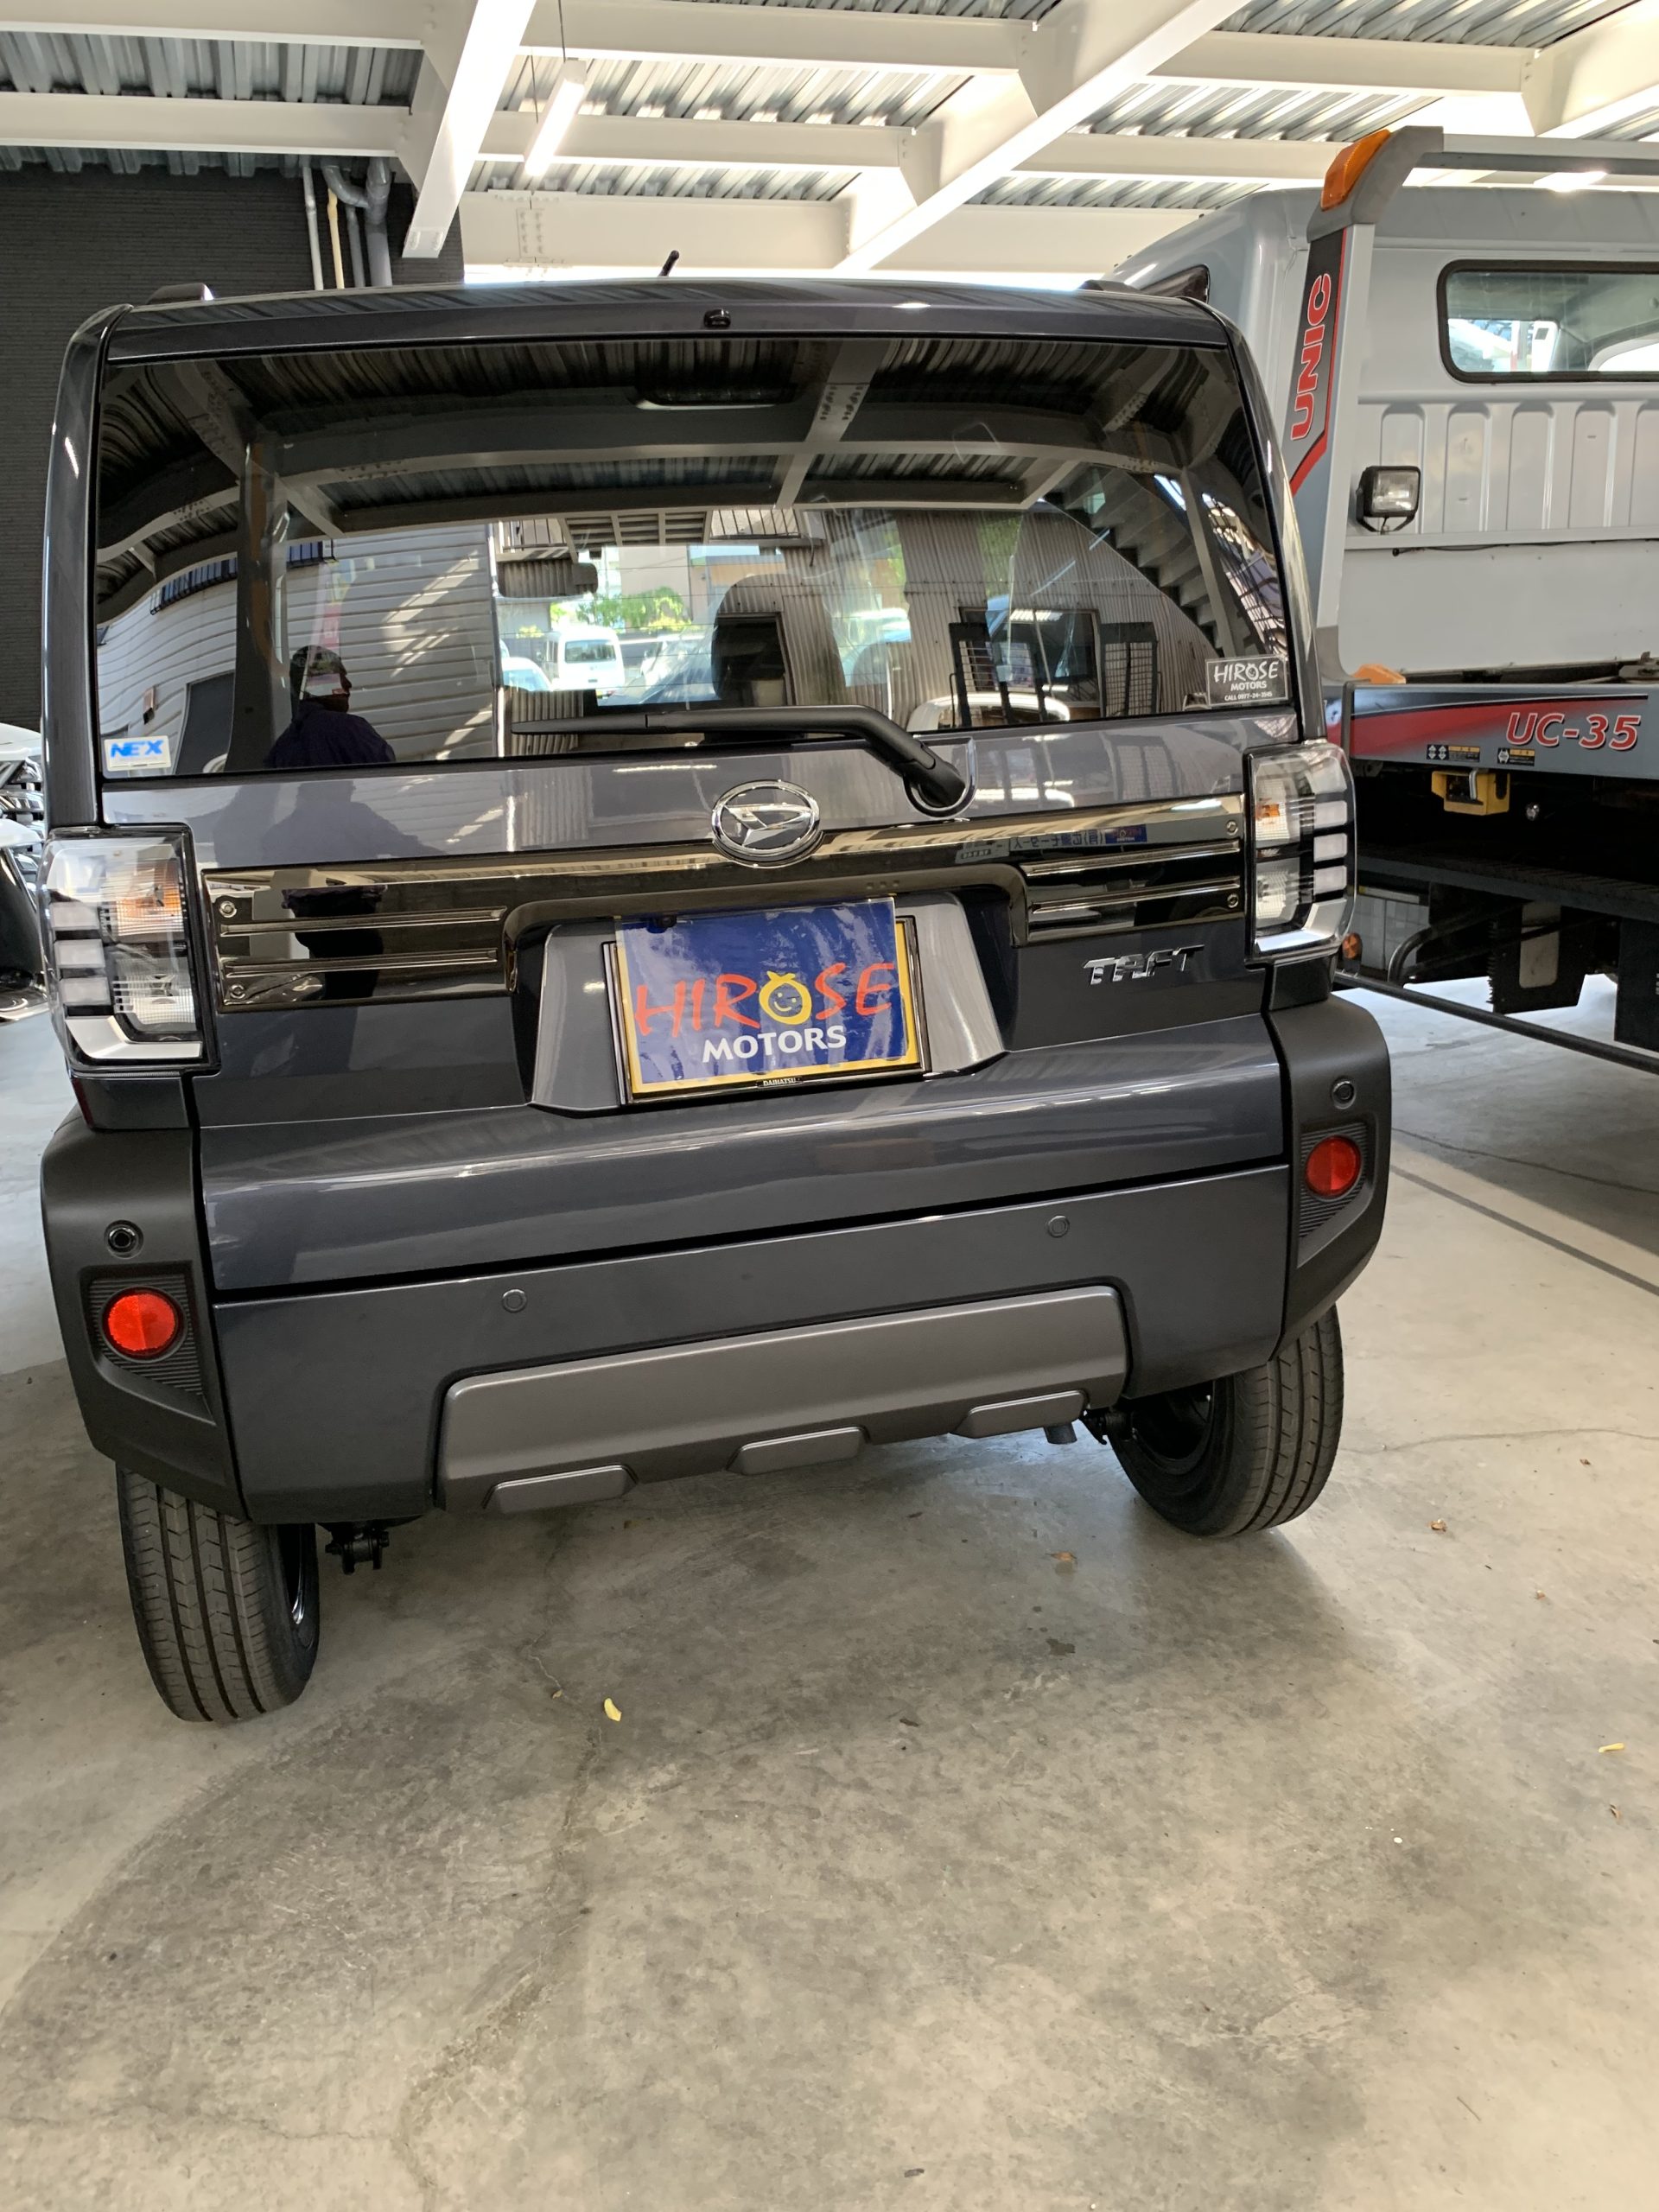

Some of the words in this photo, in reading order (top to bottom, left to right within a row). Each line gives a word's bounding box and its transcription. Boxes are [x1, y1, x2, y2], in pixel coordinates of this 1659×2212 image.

[1290, 273, 1332, 440] UNIC
[1214, 661, 1279, 683] HIROSE
[1230, 681, 1268, 691] MOTORS
[1506, 712, 1642, 751] UC-35
[111, 740, 163, 757] NEX
[634, 962, 895, 1037] HIROSE
[702, 1025, 847, 1063] MOTORS
[763, 1077, 796, 1086] DAIHATSU
